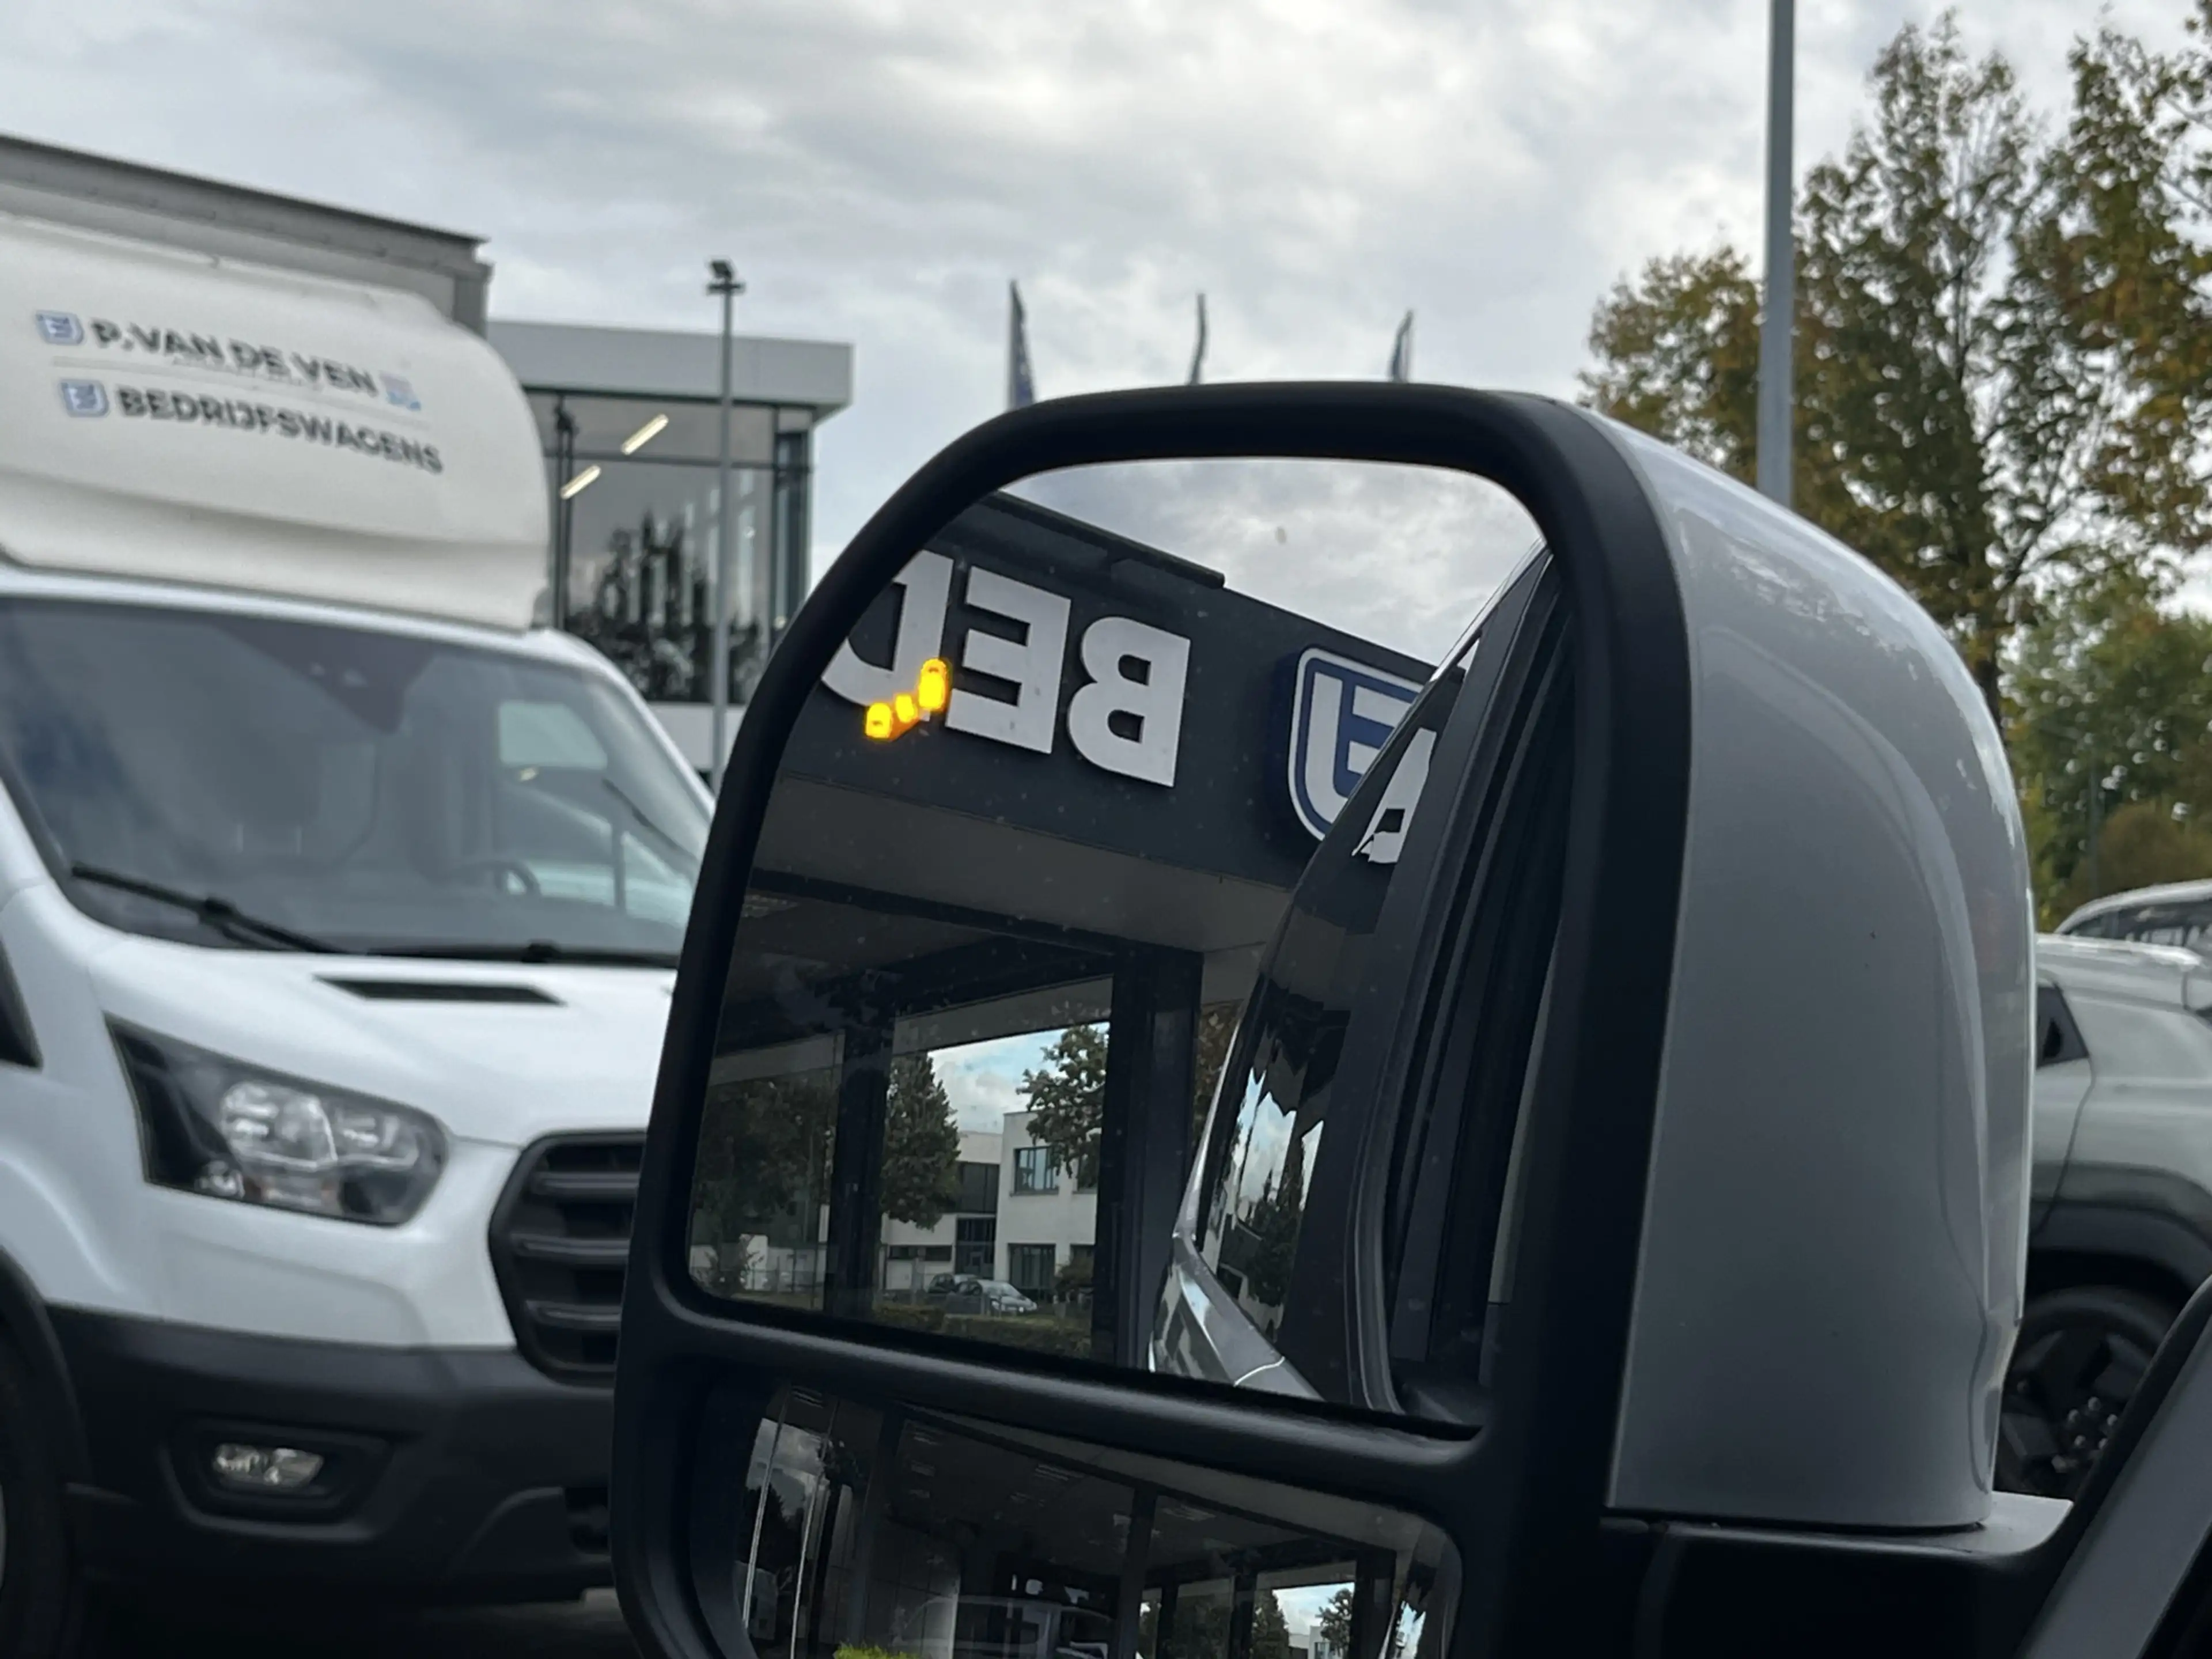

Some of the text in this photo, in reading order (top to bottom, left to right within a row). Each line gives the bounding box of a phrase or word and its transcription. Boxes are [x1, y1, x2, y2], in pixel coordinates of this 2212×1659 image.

[228, 337, 290, 377] DE
[289, 351, 378, 398] VEN
[116, 384, 444, 474] BEDRIJFSWAGENS
